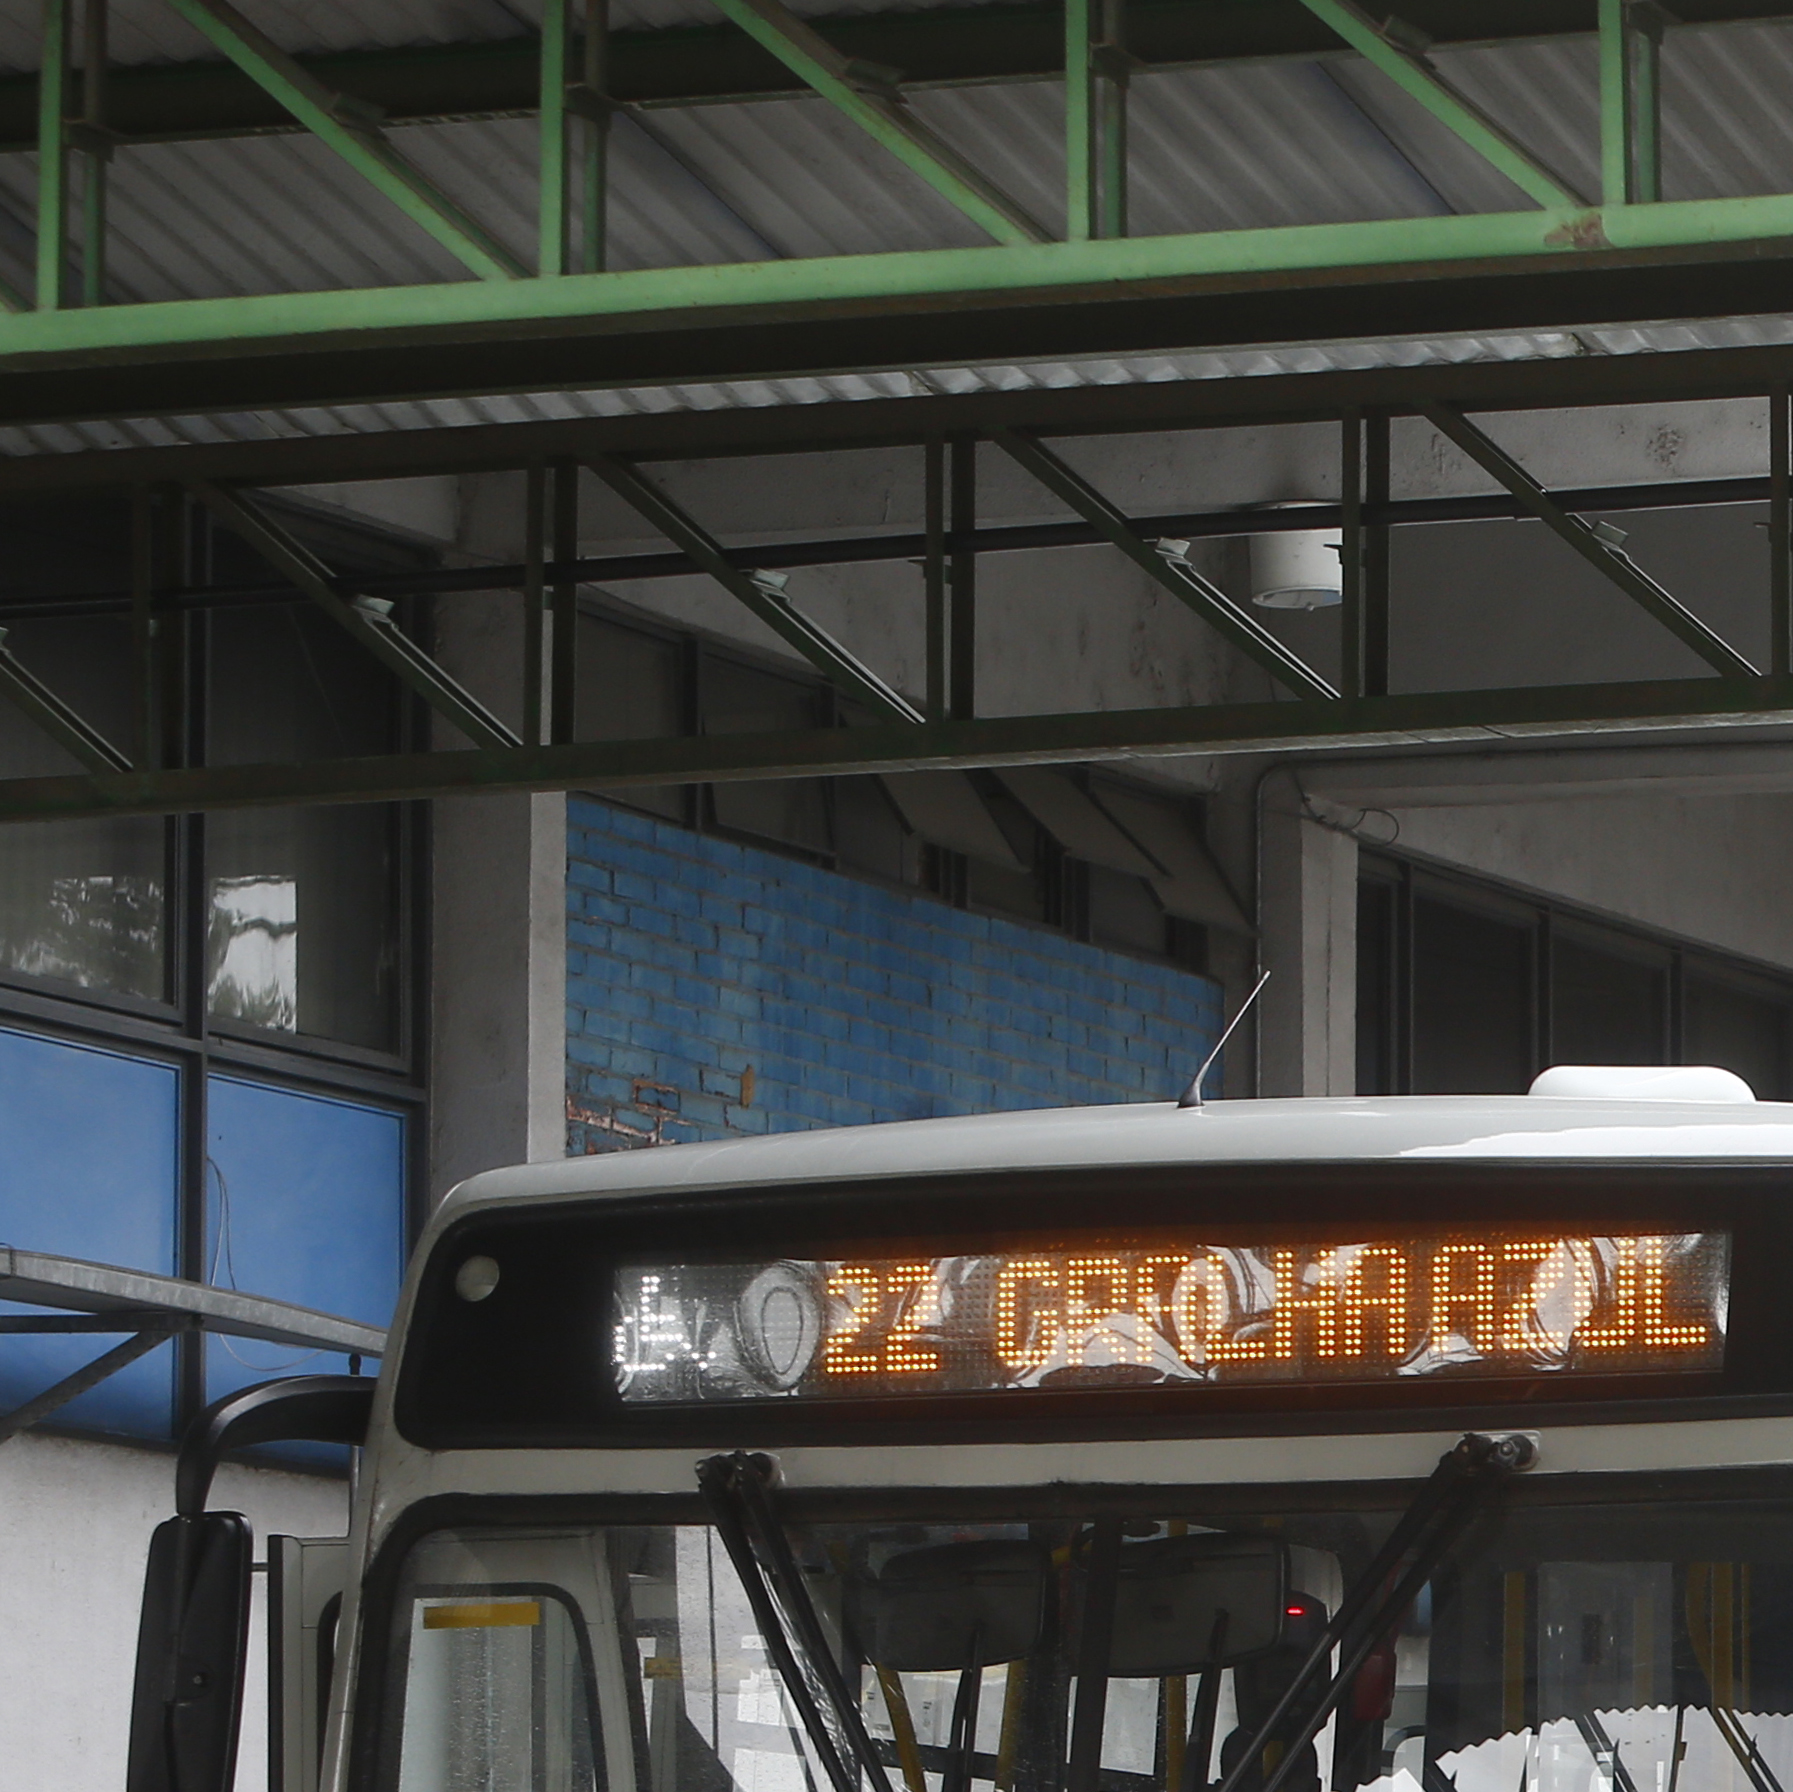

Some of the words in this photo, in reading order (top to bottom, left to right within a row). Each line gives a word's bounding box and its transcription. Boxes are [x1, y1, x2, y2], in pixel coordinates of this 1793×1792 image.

[826, 1265, 939, 1374] 22
[998, 1247, 1406, 1366] GRALHA
[1432, 1237, 1708, 1353] AZUL
